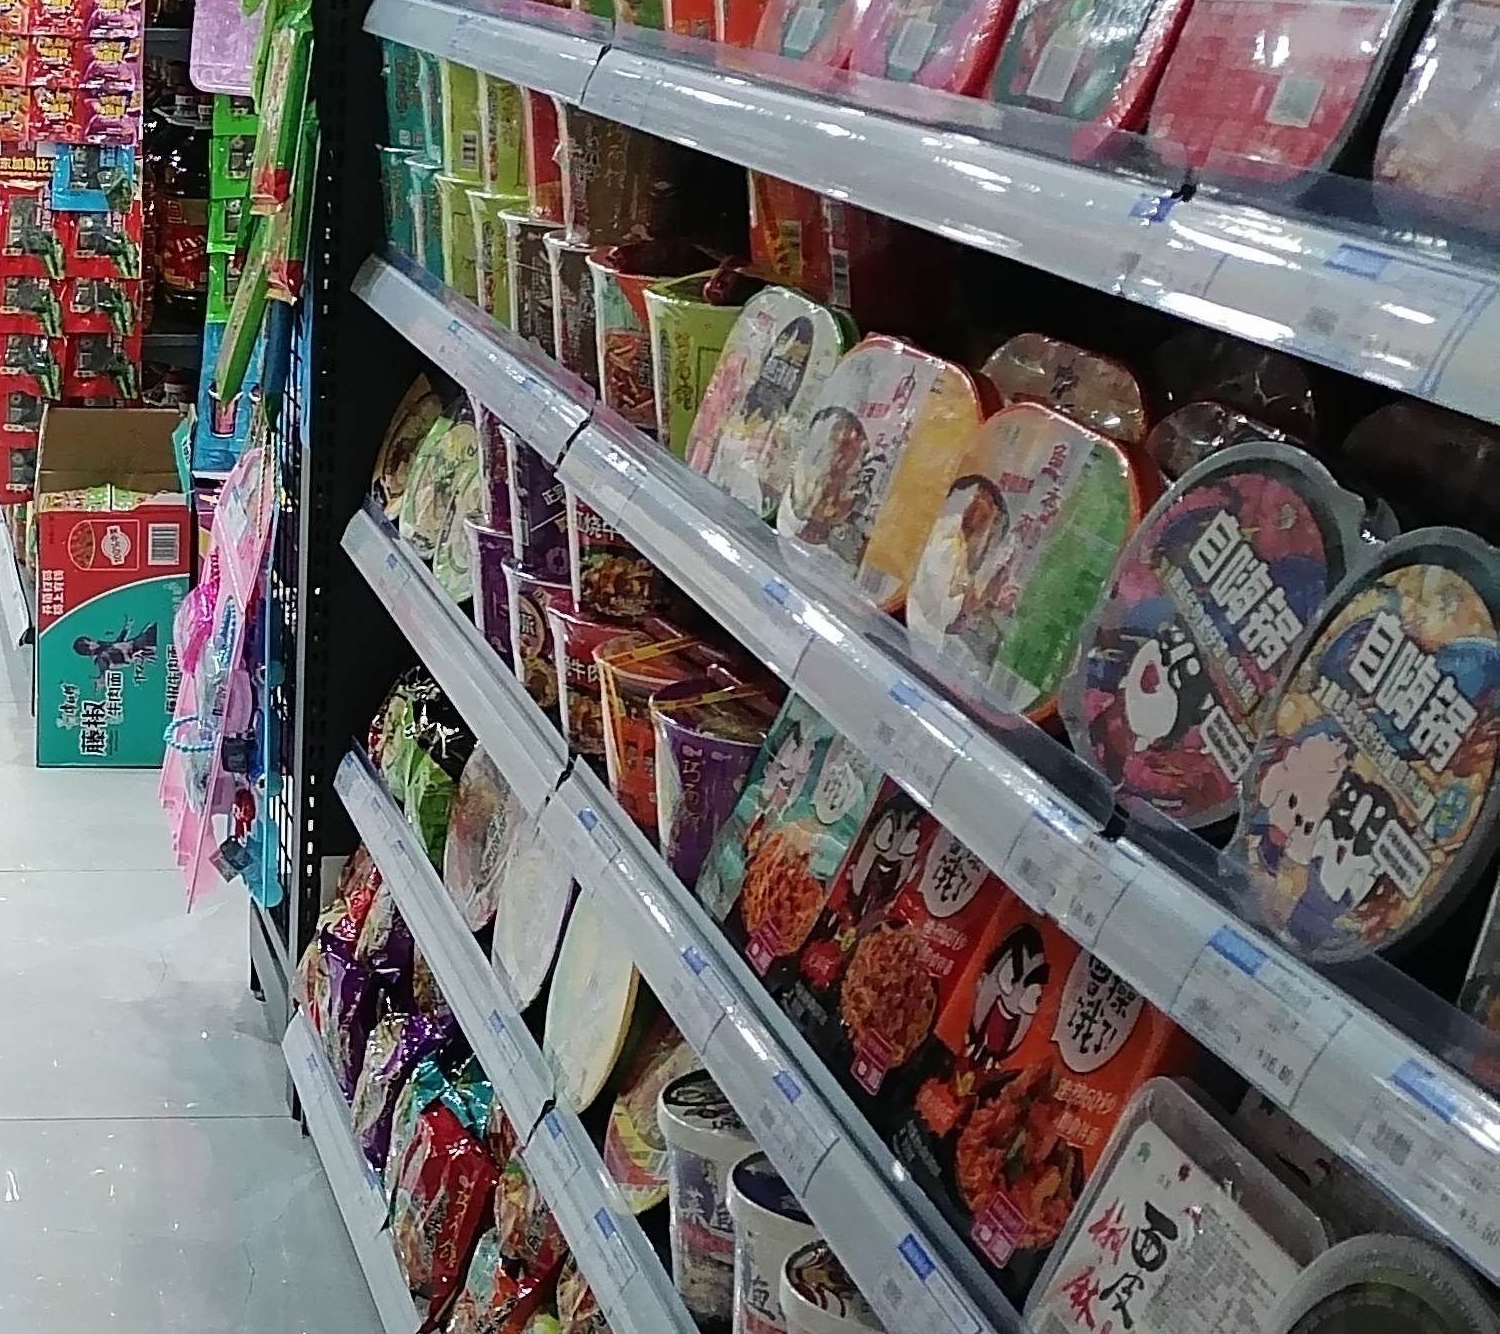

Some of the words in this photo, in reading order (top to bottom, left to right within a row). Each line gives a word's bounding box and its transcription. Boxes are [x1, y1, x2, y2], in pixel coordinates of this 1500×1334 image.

[106, 670, 123, 725] 牛肉面
[80, 699, 108, 755] 藤椒
